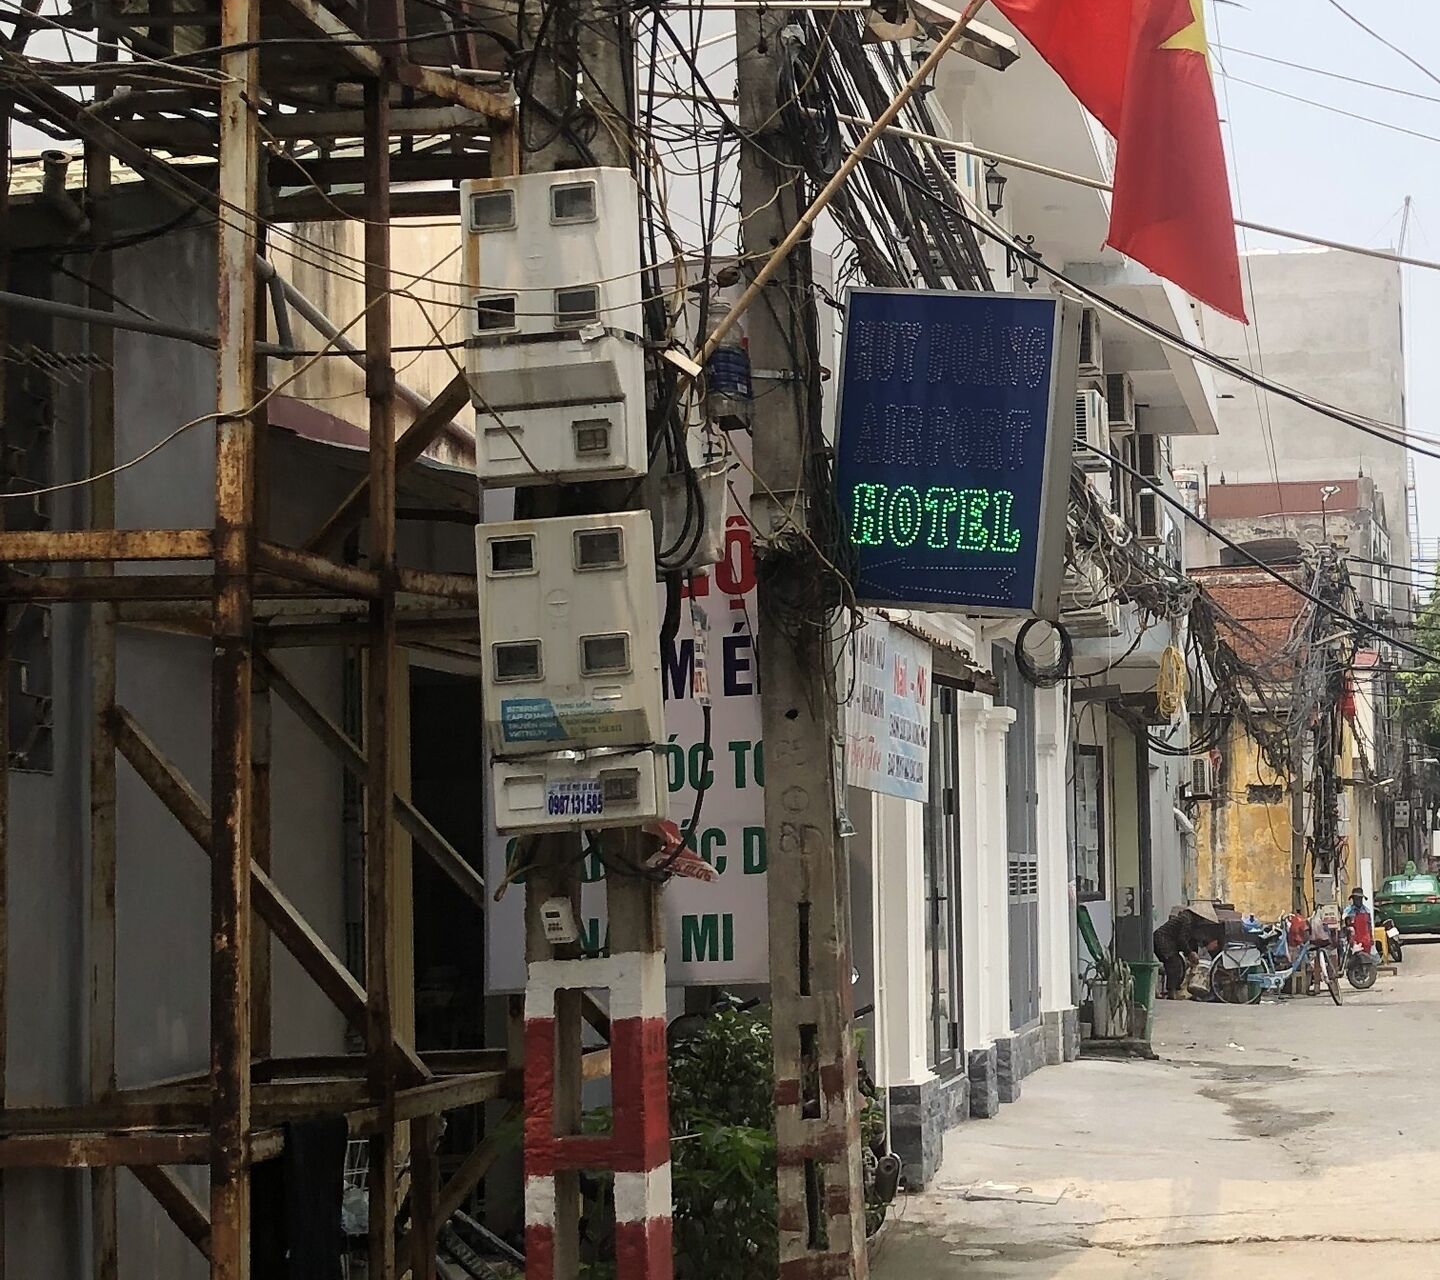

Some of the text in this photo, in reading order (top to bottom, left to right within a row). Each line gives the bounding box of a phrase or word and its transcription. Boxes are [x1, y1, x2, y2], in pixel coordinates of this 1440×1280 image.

[853, 402, 1032, 471] AIRPORT
[850, 483, 1022, 553] HOTEL
[681, 913, 734, 963] MI
